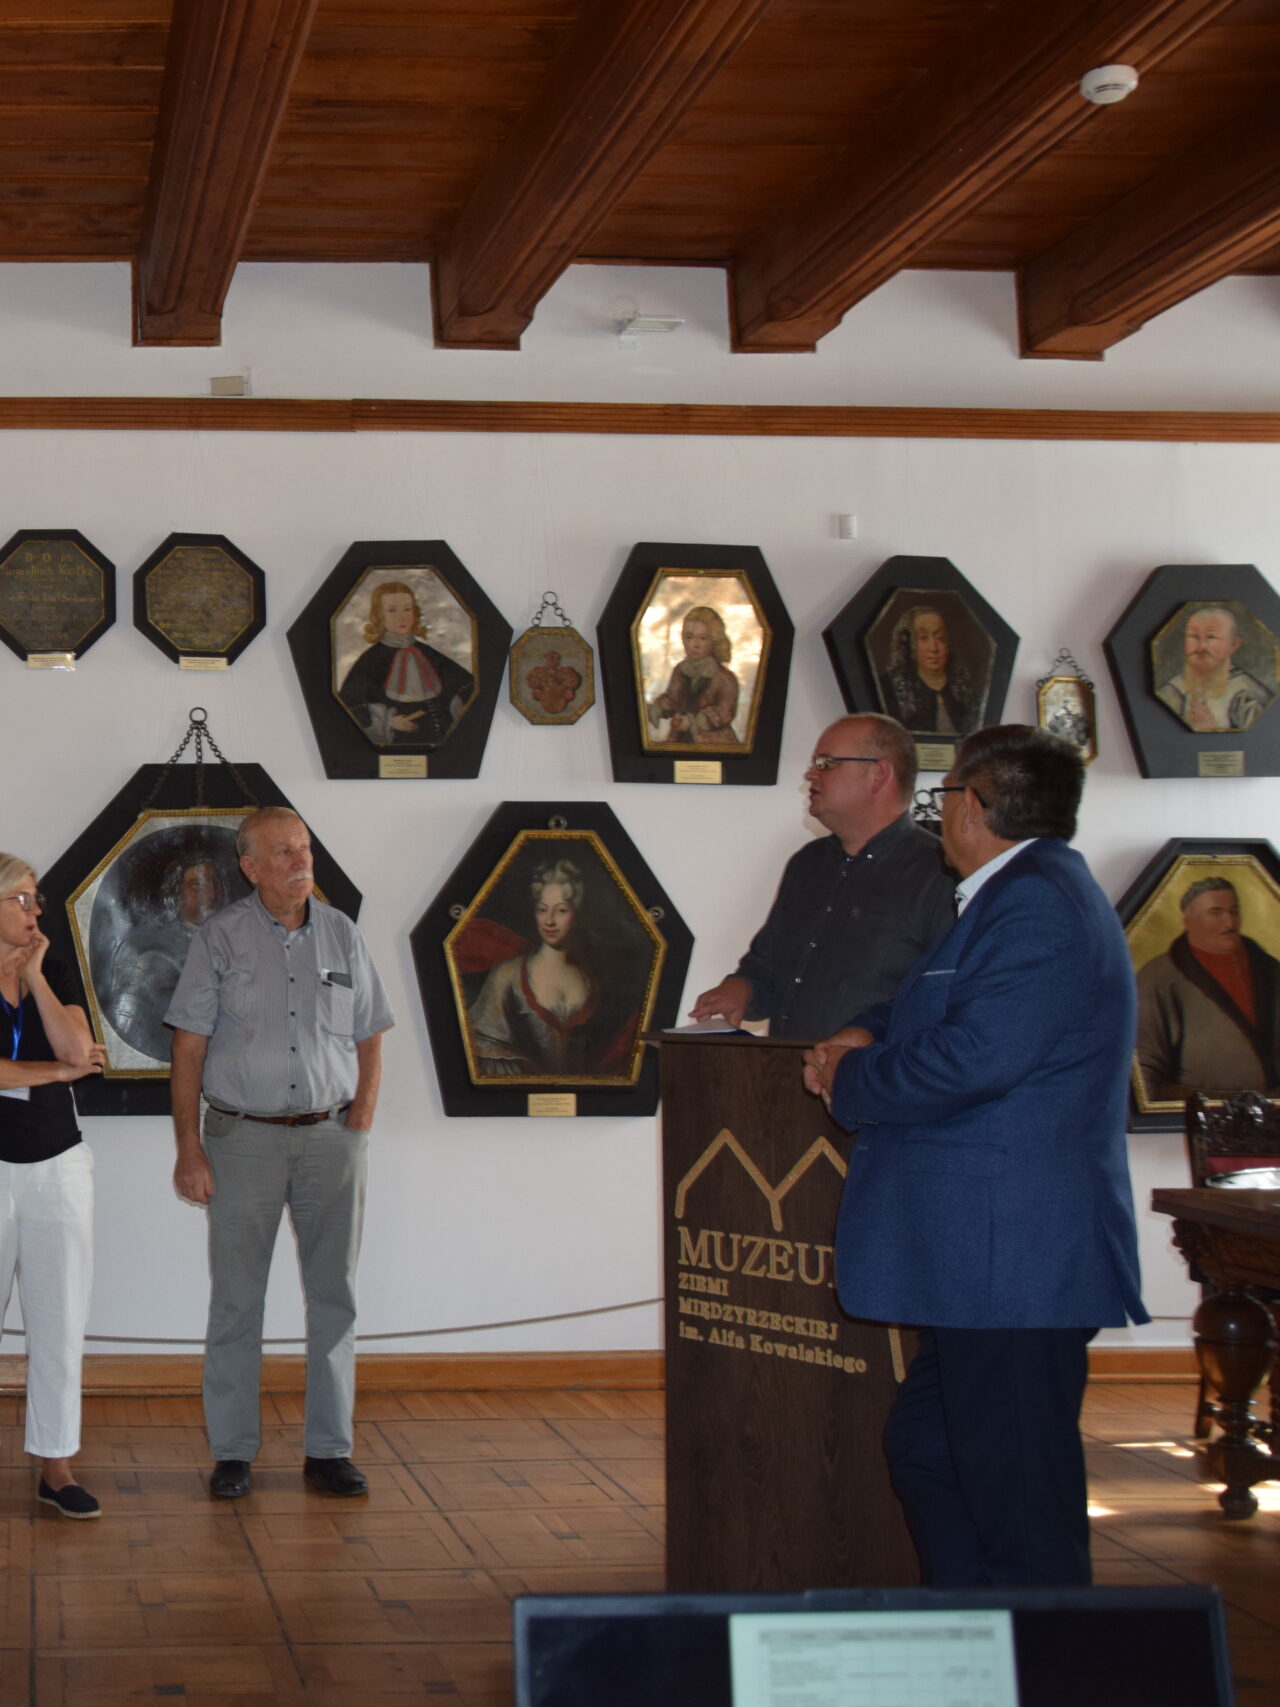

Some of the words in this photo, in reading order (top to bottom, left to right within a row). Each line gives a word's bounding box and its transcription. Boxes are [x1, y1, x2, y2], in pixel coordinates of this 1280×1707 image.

[677, 1226, 835, 1288] MUZEU
[678, 1272, 729, 1296] ZIEMI
[679, 1321, 705, 1342] im.
[708, 1327, 745, 1349] Alfa
[750, 1334, 867, 1373] Kowalskiego
